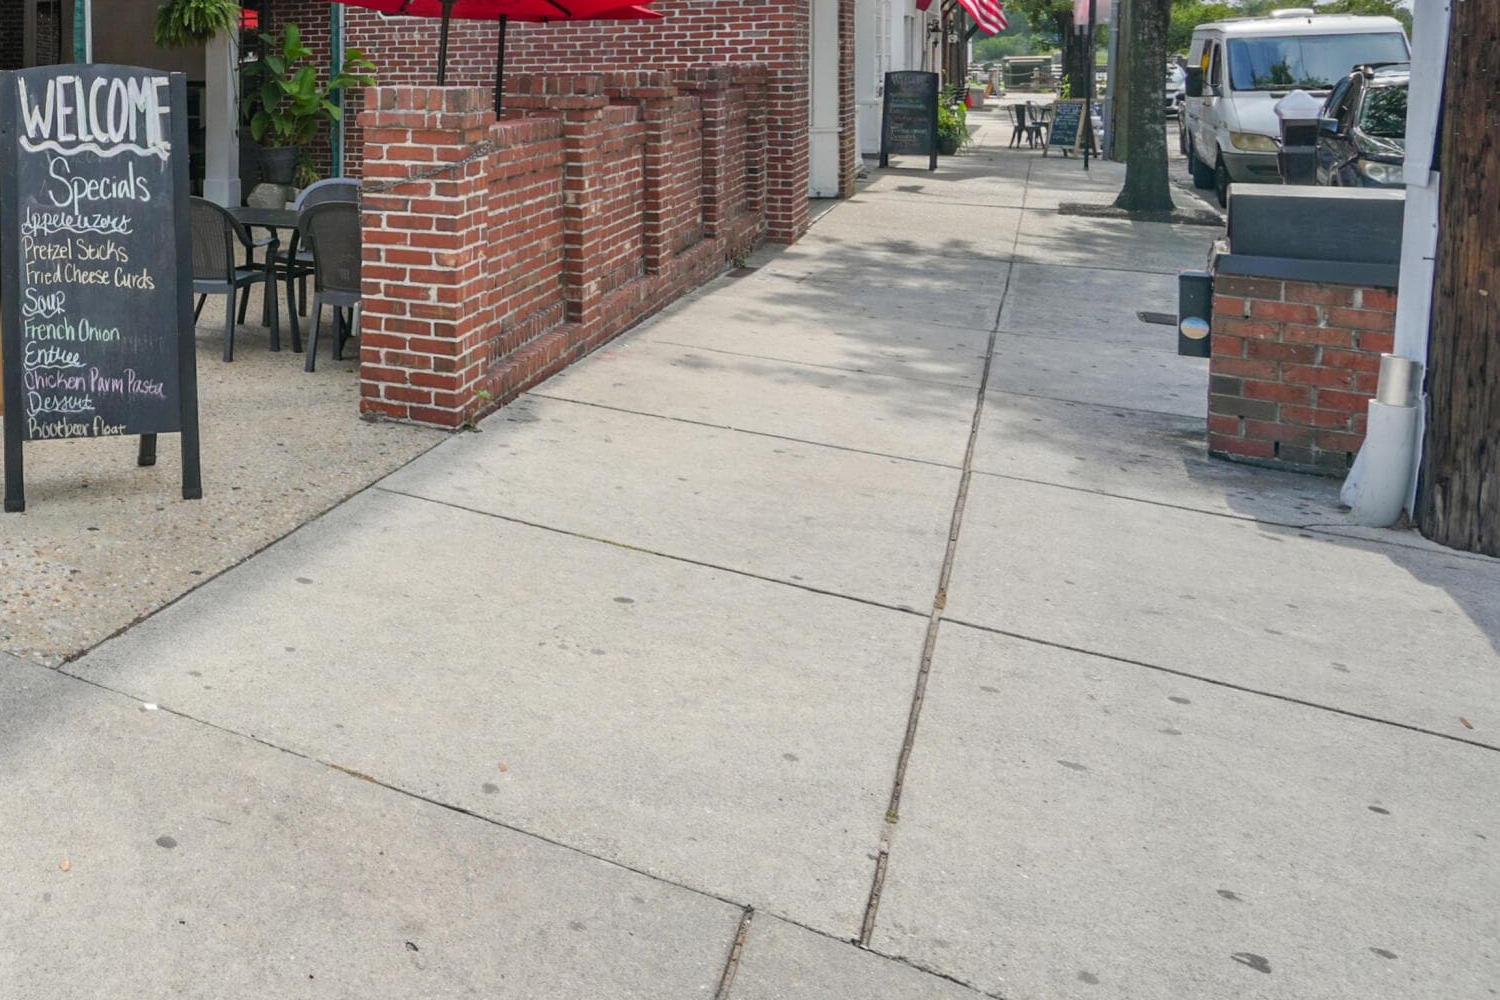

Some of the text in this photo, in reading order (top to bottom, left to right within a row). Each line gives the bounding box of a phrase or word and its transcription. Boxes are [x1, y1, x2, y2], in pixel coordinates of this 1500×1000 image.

[18, 75, 171, 148] WELCOME
[48, 156, 151, 215] Specials
[22, 235, 129, 262] Pretzel Sticks
[26, 261, 155, 290] Fried Cheese Curds
[23, 287, 66, 315] Soup
[24, 316, 120, 342] French Onion
[24, 341, 82, 367] Entree
[24, 367, 167, 399] Chicken Parm Pasta
[27, 391, 96, 416] Dessert
